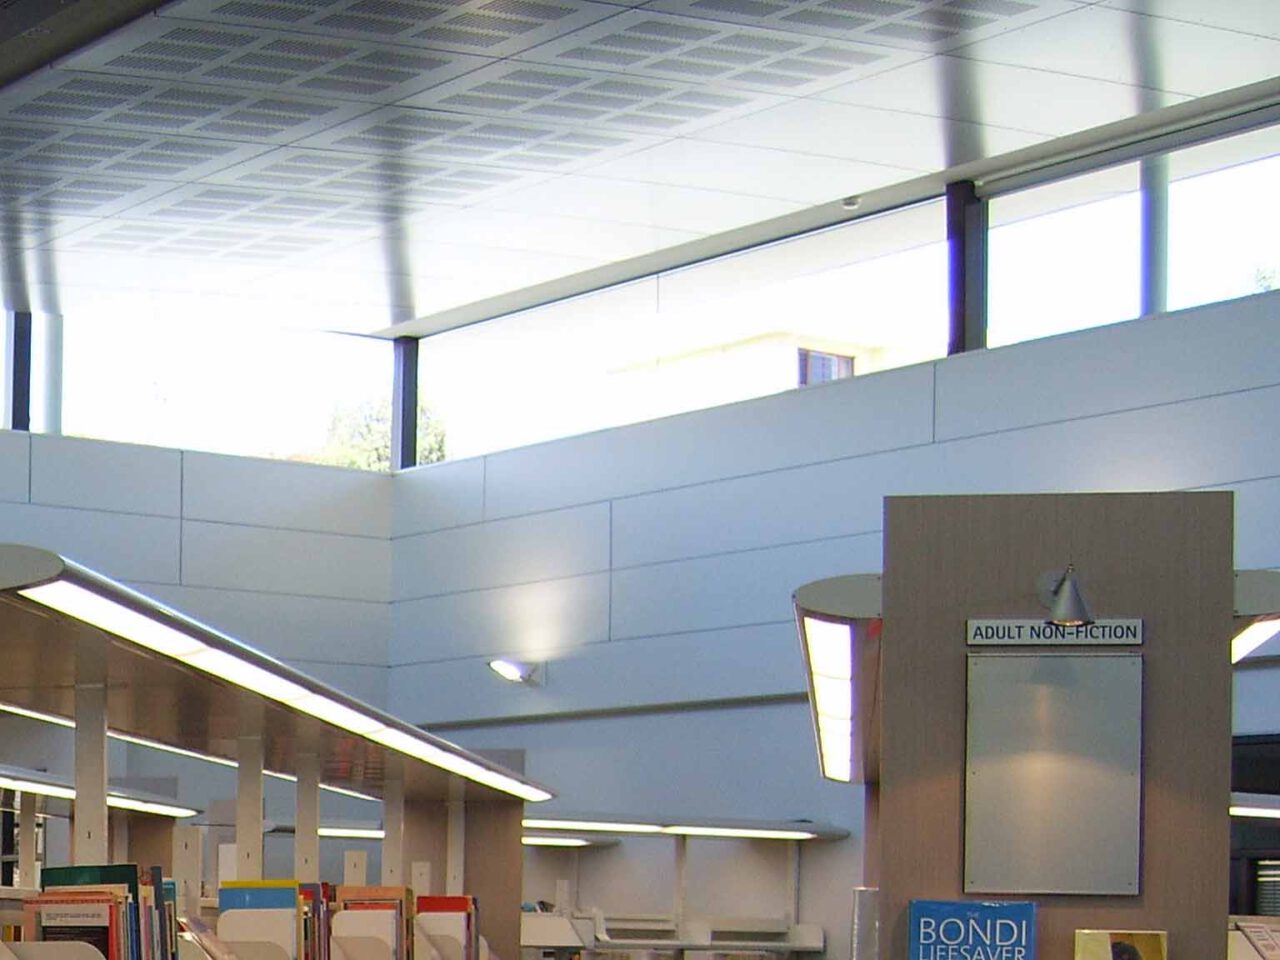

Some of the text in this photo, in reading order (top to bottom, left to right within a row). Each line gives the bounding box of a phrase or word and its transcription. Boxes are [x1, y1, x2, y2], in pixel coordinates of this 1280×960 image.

[972, 625, 1137, 640] ADULT NON-FICTION
[920, 918, 1026, 946] BONDI
